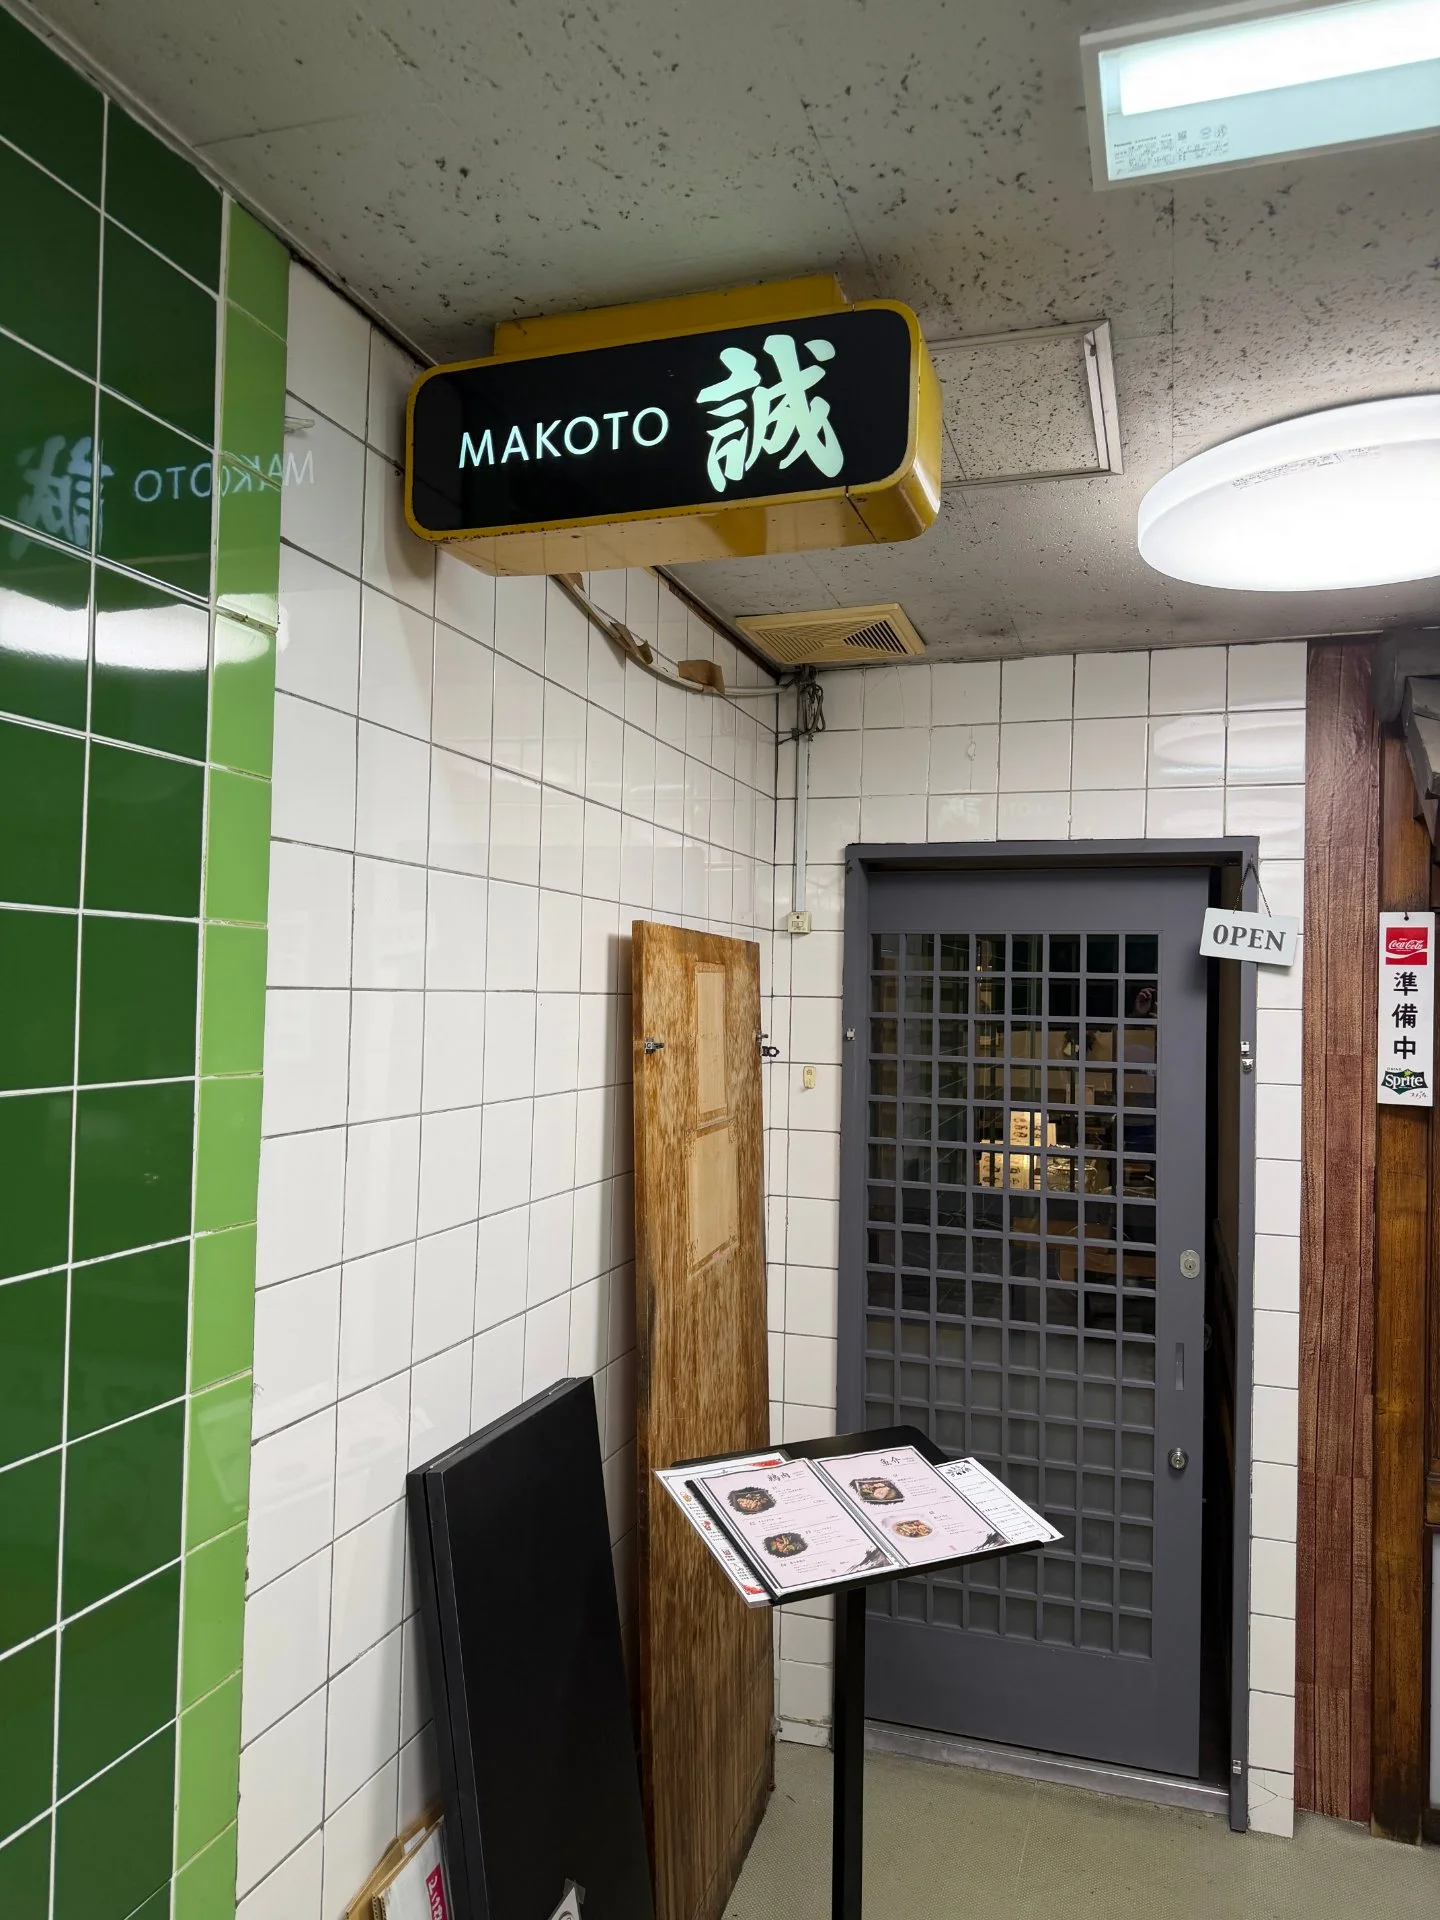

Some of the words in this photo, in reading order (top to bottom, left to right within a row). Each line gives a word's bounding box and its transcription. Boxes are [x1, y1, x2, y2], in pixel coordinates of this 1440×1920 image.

[695, 333, 844, 493] 誠
[458, 406, 670, 469] MAKOTO
[1212, 924, 1287, 952] OPEN
[1388, 939, 1424, 950] Coca-Cola
[1391, 971, 1419, 1060] 準備中
[1385, 1074, 1424, 1090] Sprite
